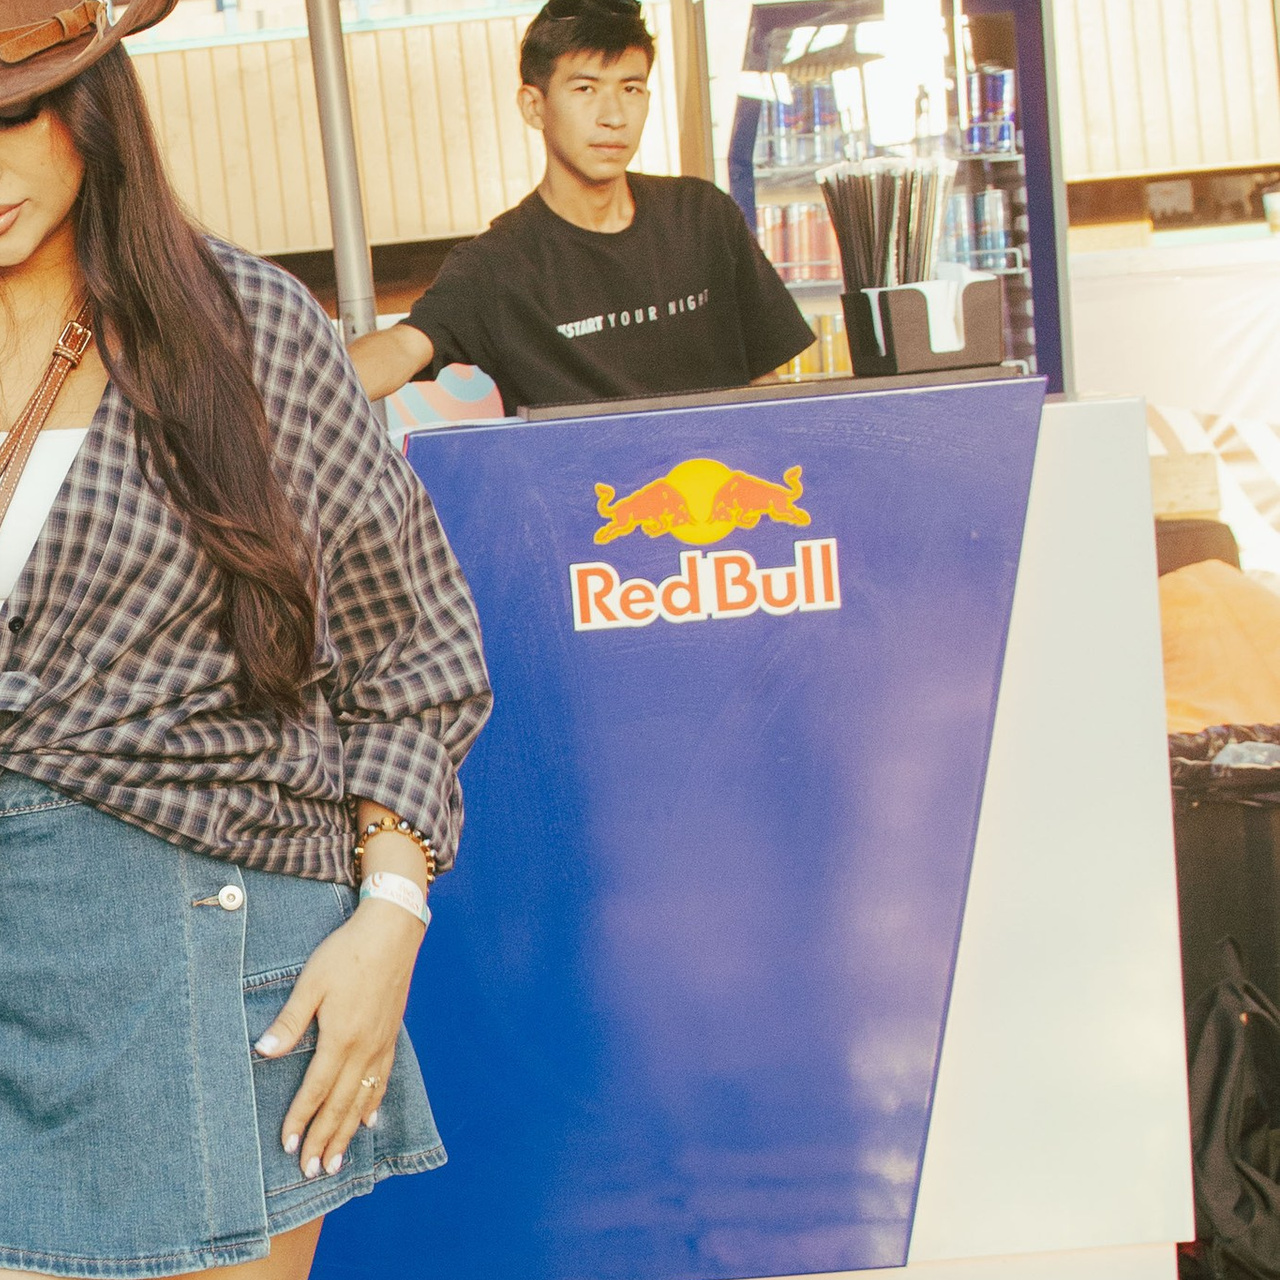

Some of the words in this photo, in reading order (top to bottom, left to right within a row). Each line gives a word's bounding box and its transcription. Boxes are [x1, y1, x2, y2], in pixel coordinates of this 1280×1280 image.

[607, 305, 658, 328] YOUR
[575, 555, 702, 625] Red
[712, 543, 836, 613] Bull
